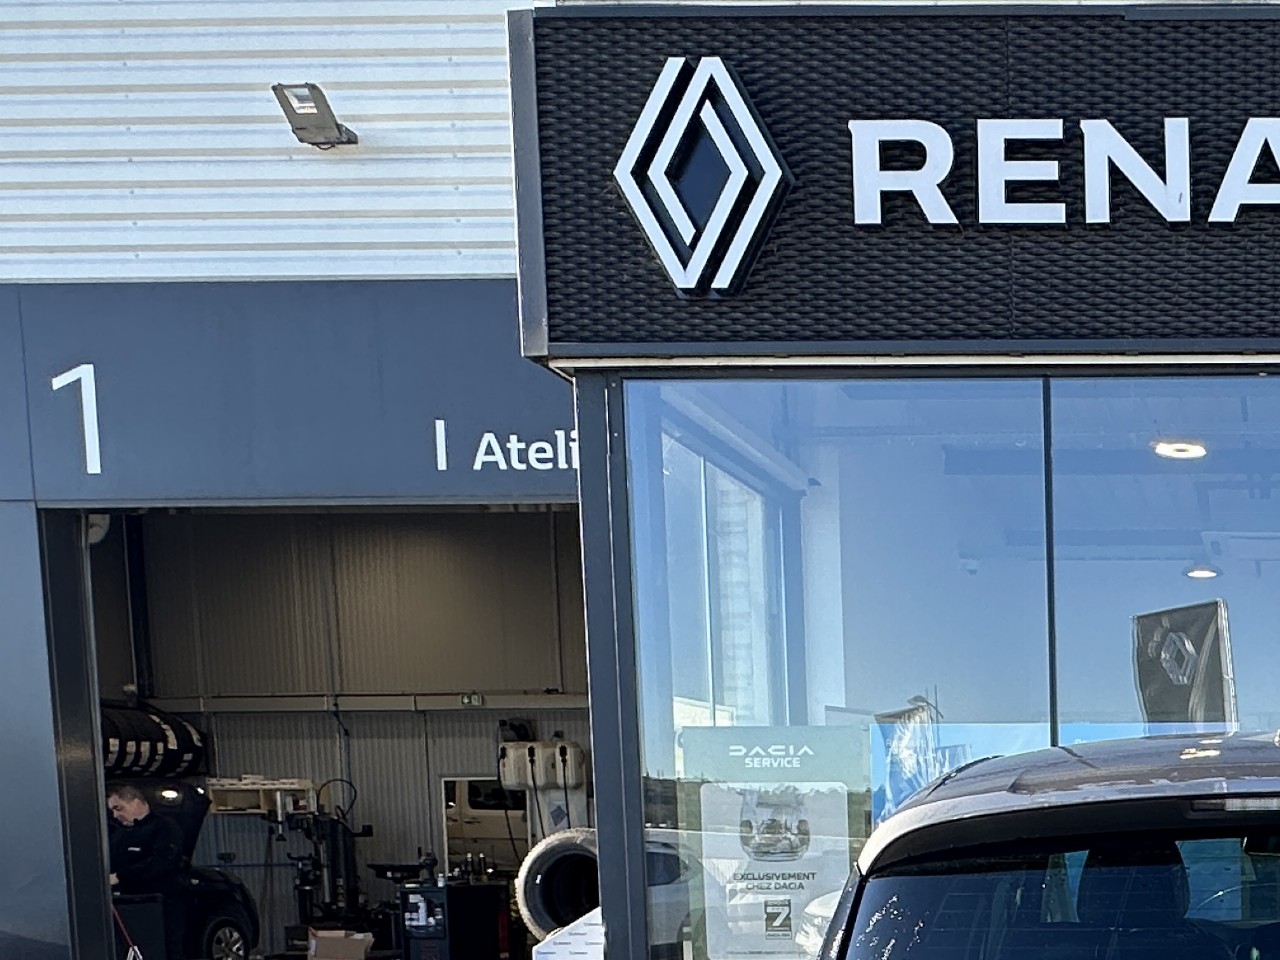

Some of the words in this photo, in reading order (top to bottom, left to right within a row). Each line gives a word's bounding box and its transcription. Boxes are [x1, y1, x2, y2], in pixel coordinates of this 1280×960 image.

[51, 363, 102, 475] 1
[728, 744, 815, 757] DACIA
[744, 756, 801, 769] SERVICE
[733, 872, 817, 881] EXCLUSIVEMENT
[746, 882, 772, 891] CHEZ
[774, 881, 805, 890] DACIA
